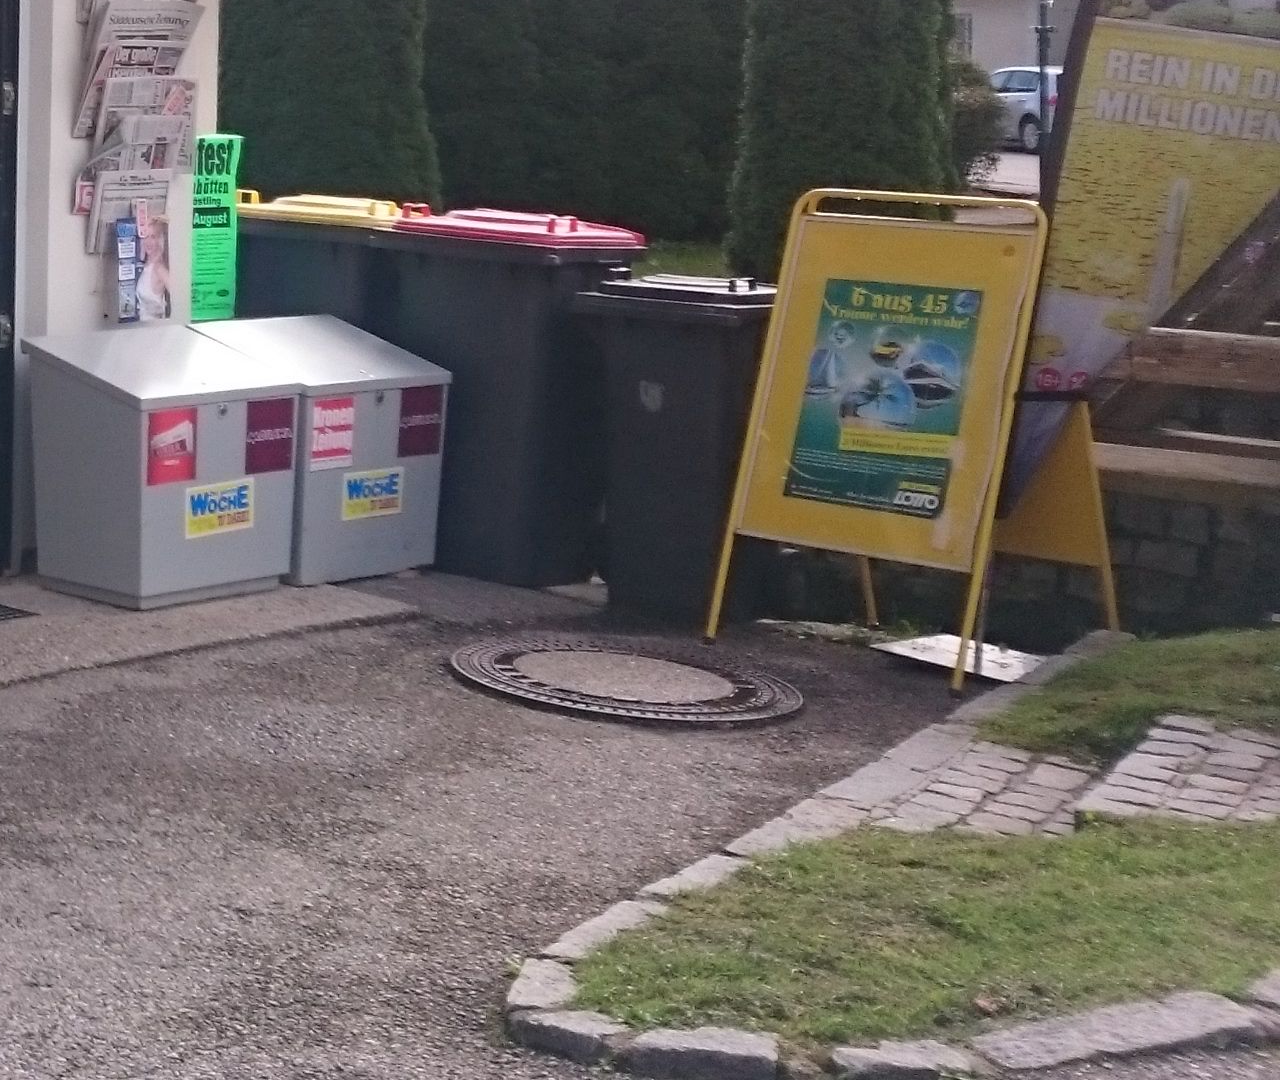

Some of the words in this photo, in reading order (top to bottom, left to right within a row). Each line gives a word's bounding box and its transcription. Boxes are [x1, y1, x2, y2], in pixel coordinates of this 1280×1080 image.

[1107, 47, 1192, 90] REIN
[1201, 62, 1240, 96] IN
[193, 138, 235, 177] fest
[194, 211, 228, 227] August
[852, 287, 865, 307] 6
[871, 294, 913, 313] aus
[919, 293, 950, 314] 45
[346, 473, 400, 500] WOCHE
[893, 490, 940, 510] LOTTO
[191, 484, 250, 517] WOCHE
